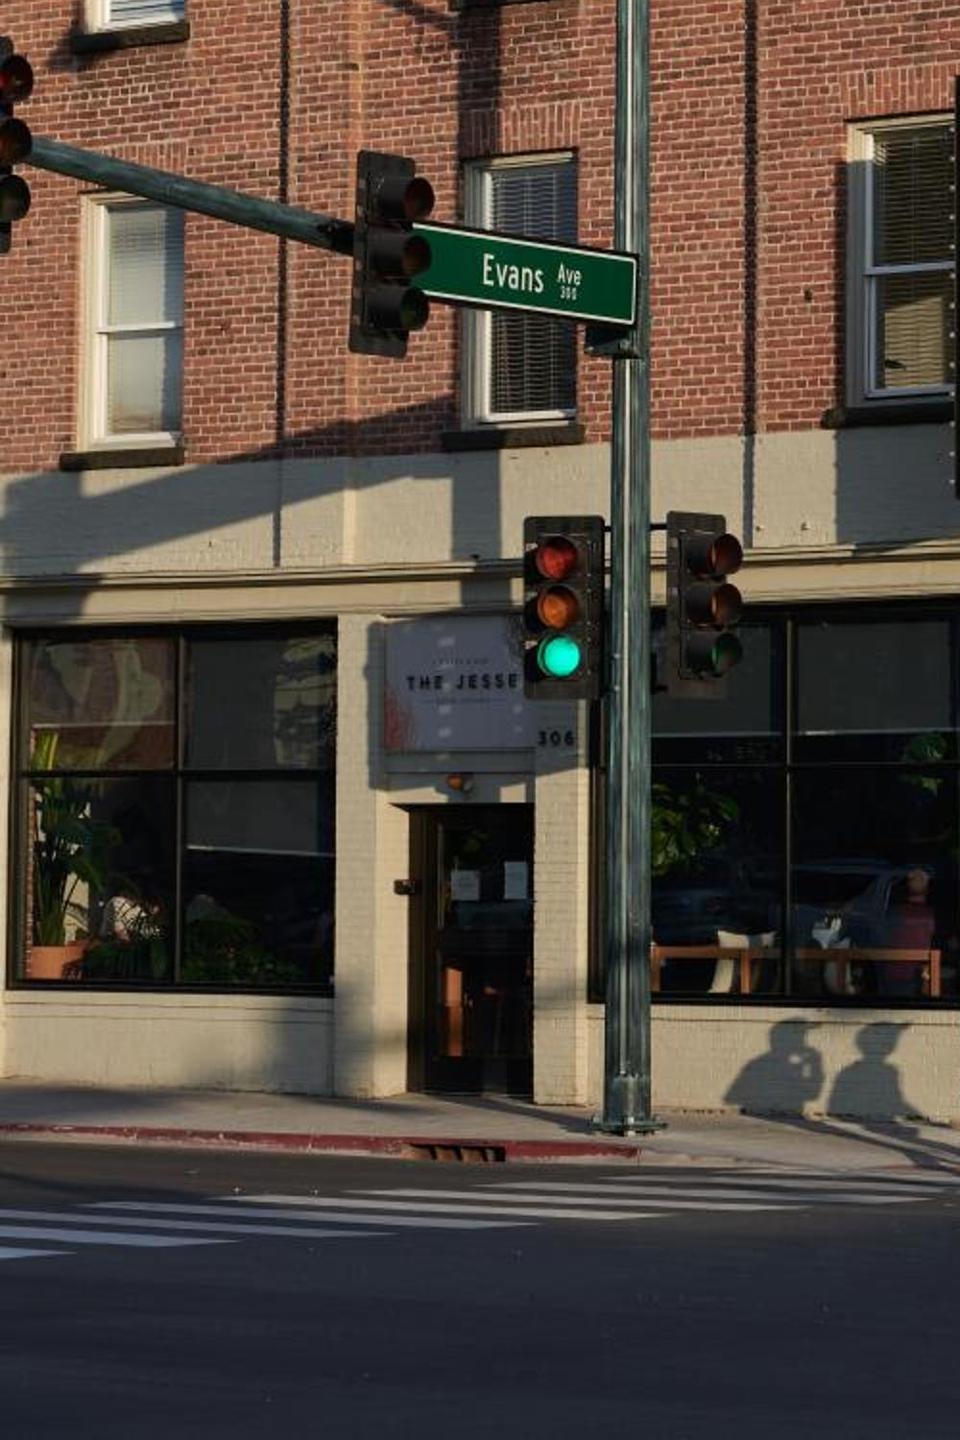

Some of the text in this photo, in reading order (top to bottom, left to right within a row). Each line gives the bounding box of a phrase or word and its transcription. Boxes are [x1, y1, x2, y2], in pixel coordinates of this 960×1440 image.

[482, 253, 582, 293] Evans Ave
[560, 285, 577, 301] 300
[406, 673, 518, 691] THE JESSE
[537, 730, 575, 747] 306
